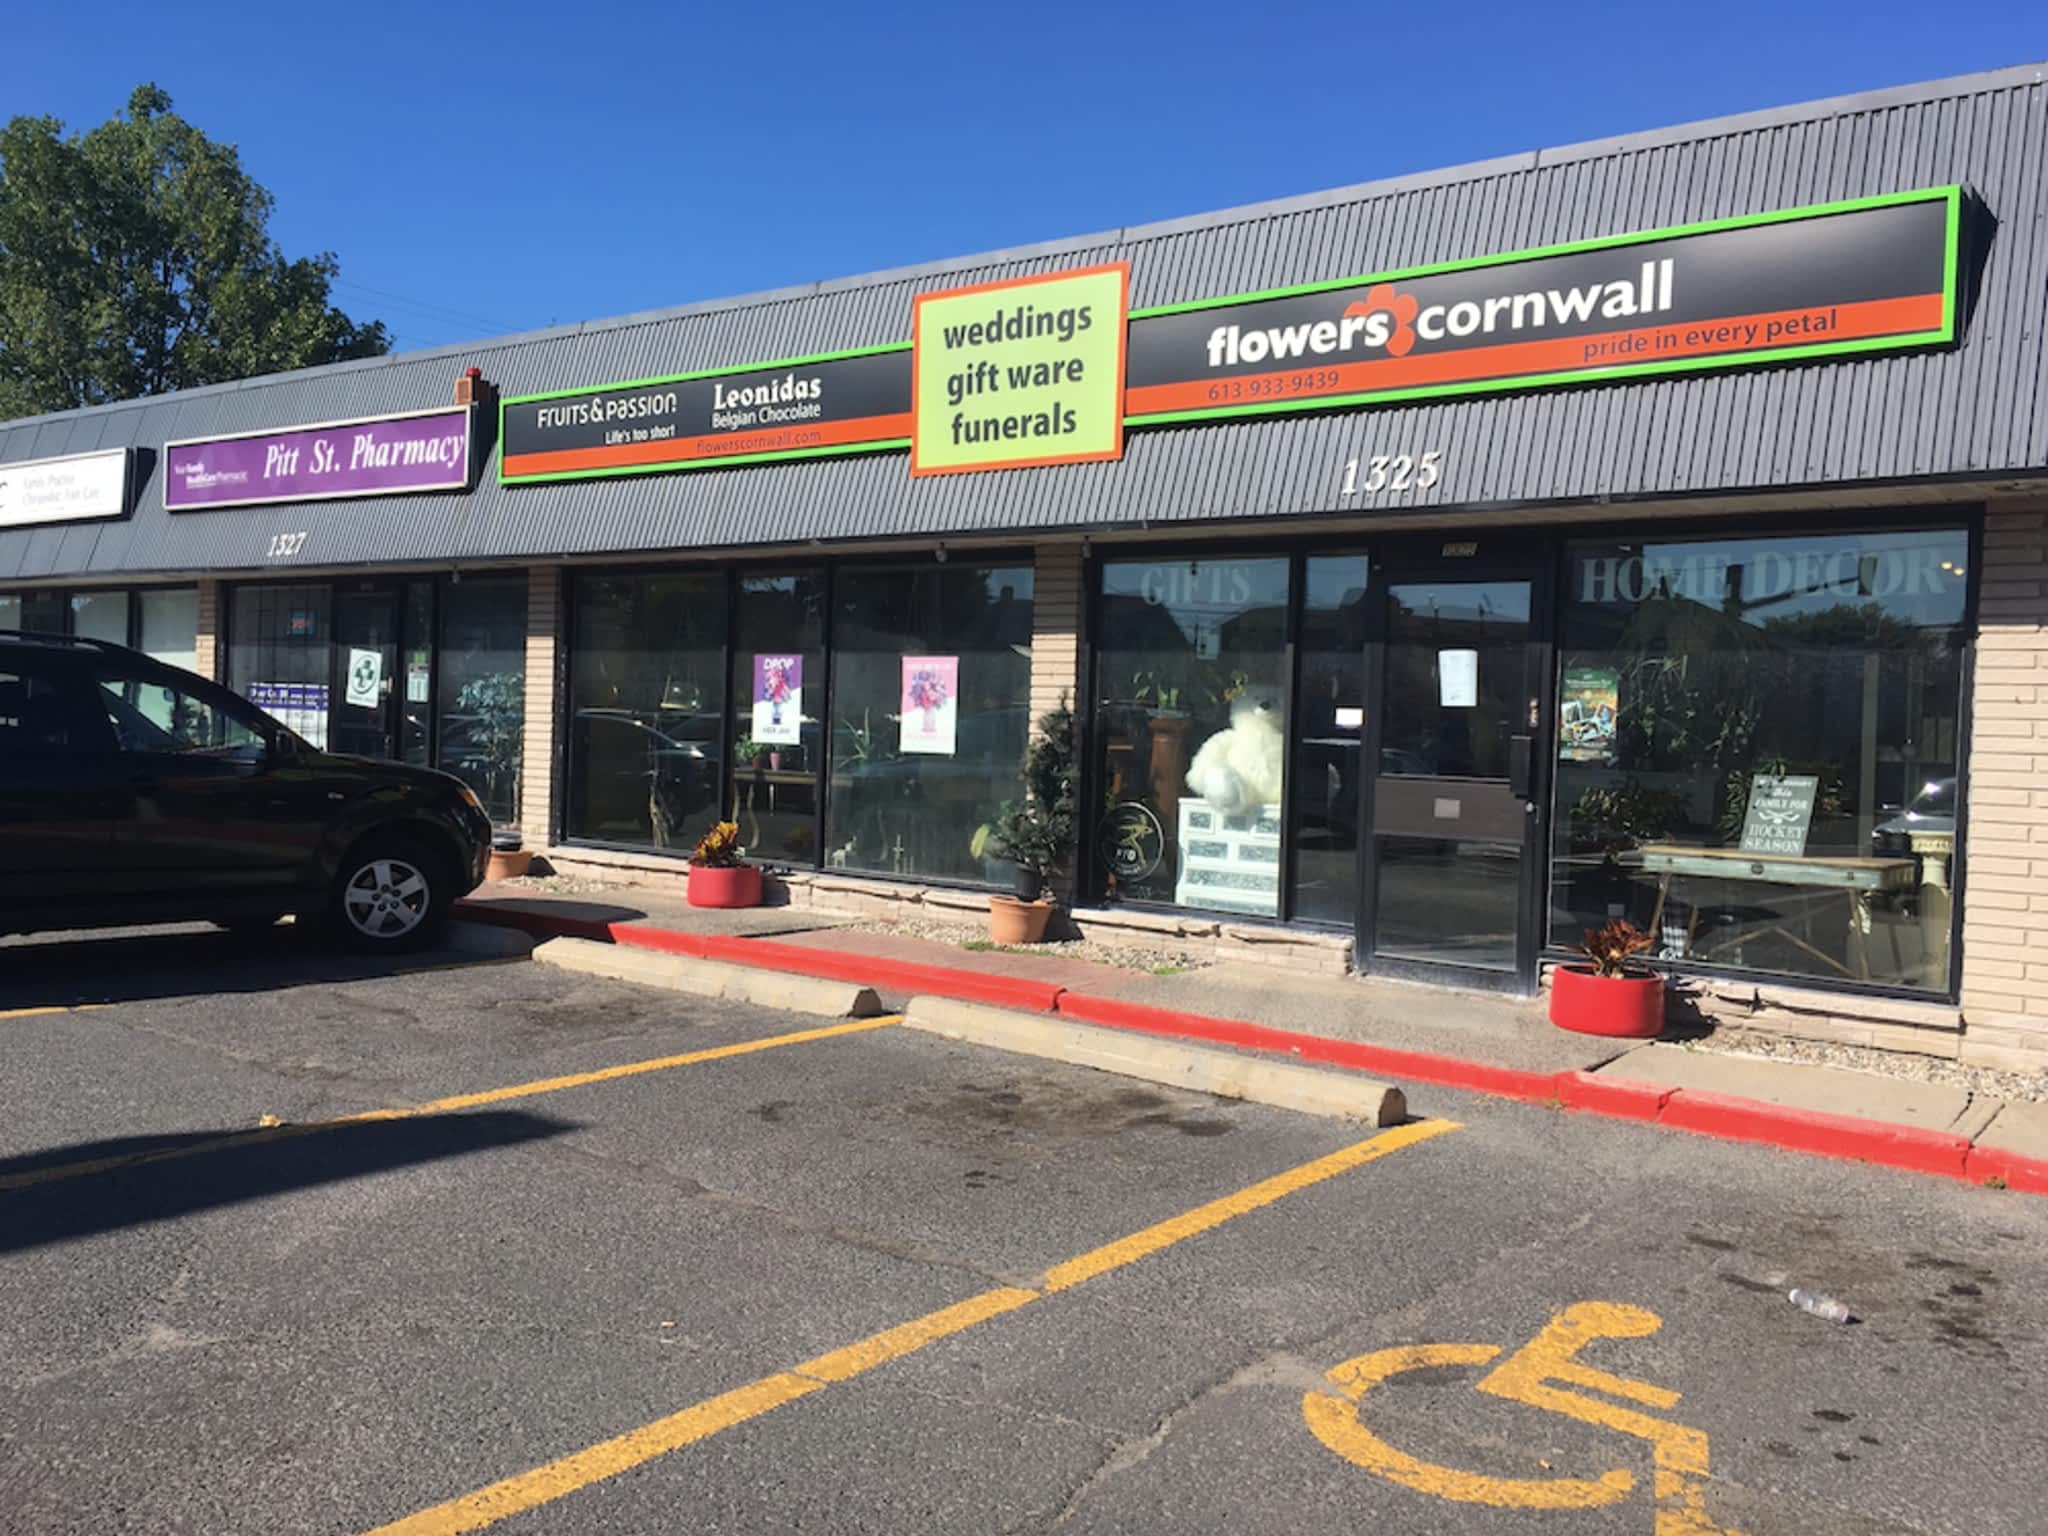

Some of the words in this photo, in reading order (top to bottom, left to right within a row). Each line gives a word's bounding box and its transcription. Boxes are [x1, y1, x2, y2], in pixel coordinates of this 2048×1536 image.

[944, 304, 1092, 349] weddings
[1207, 312, 1390, 367] flowers
[1417, 259, 1675, 341] cornwall
[1583, 337, 1648, 362] pride
[1655, 332, 1678, 351] in
[1685, 321, 1758, 347] every
[1766, 309, 1838, 342] petal
[713, 373, 822, 410] Leonidas
[947, 360, 999, 406] gift
[1007, 357, 1084, 389] ware
[1208, 370, 1340, 401] 613-933-9439
[605, 430, 631, 445] Life's
[633, 428, 648, 442] too
[650, 423, 676, 439] short
[711, 410, 756, 430] Belgian
[759, 401, 821, 423] Chocolate
[952, 401, 1077, 445] funerals
[263, 442, 299, 479] Pitt
[309, 438, 341, 475] St.
[350, 433, 465, 471] Pharmacy
[697, 431, 823, 454] flowerscornwall.com
[1341, 451, 1440, 495] 1325
[267, 532, 307, 558] 1327
[1141, 566, 1250, 606] GIFTS
[1581, 556, 1735, 602] HOME
[1752, 548, 1947, 599] DECOR
[1744, 837, 1801, 853] SEASON
